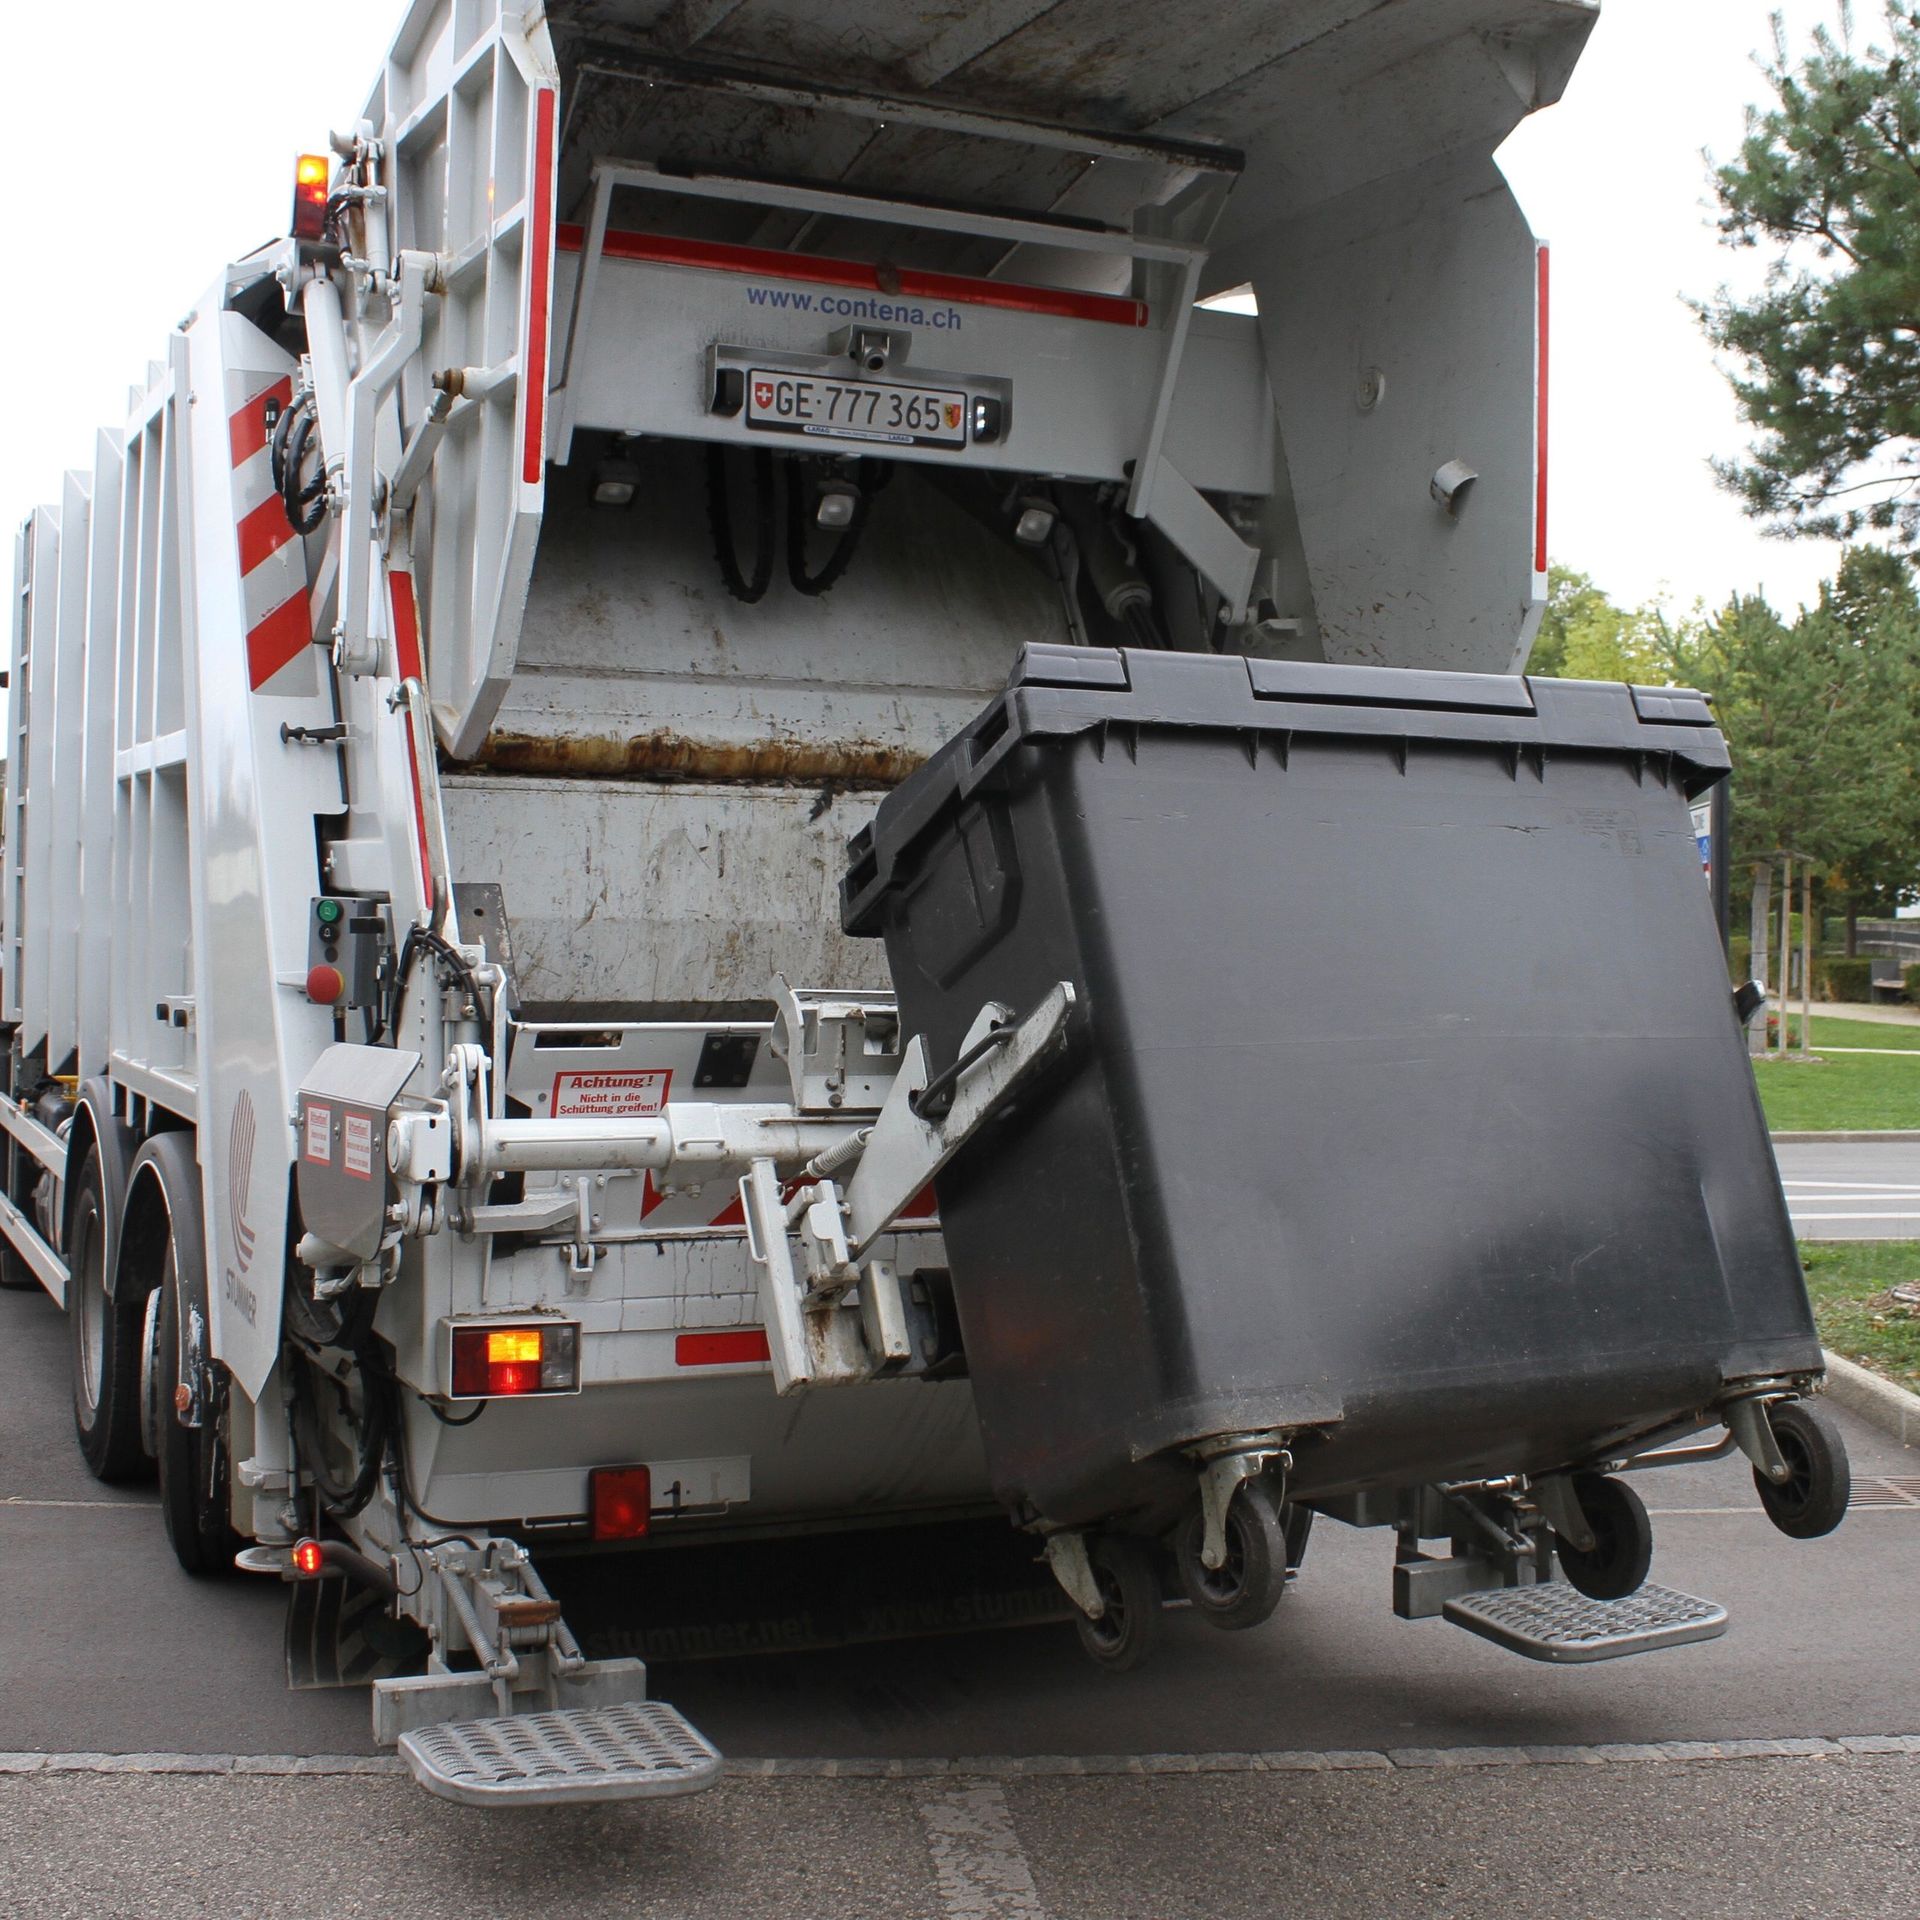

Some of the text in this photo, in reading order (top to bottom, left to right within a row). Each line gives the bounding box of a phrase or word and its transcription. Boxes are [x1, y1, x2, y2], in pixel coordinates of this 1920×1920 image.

[747, 288, 961, 330] www.contena.ch
[887, 394, 941, 431] 365
[571, 1075, 653, 1088] Achtung!
[560, 1102, 658, 1114] Schüttung greifen!
[579, 1092, 641, 1103] Nicht in die
[226, 1267, 257, 1329] STUMMER
